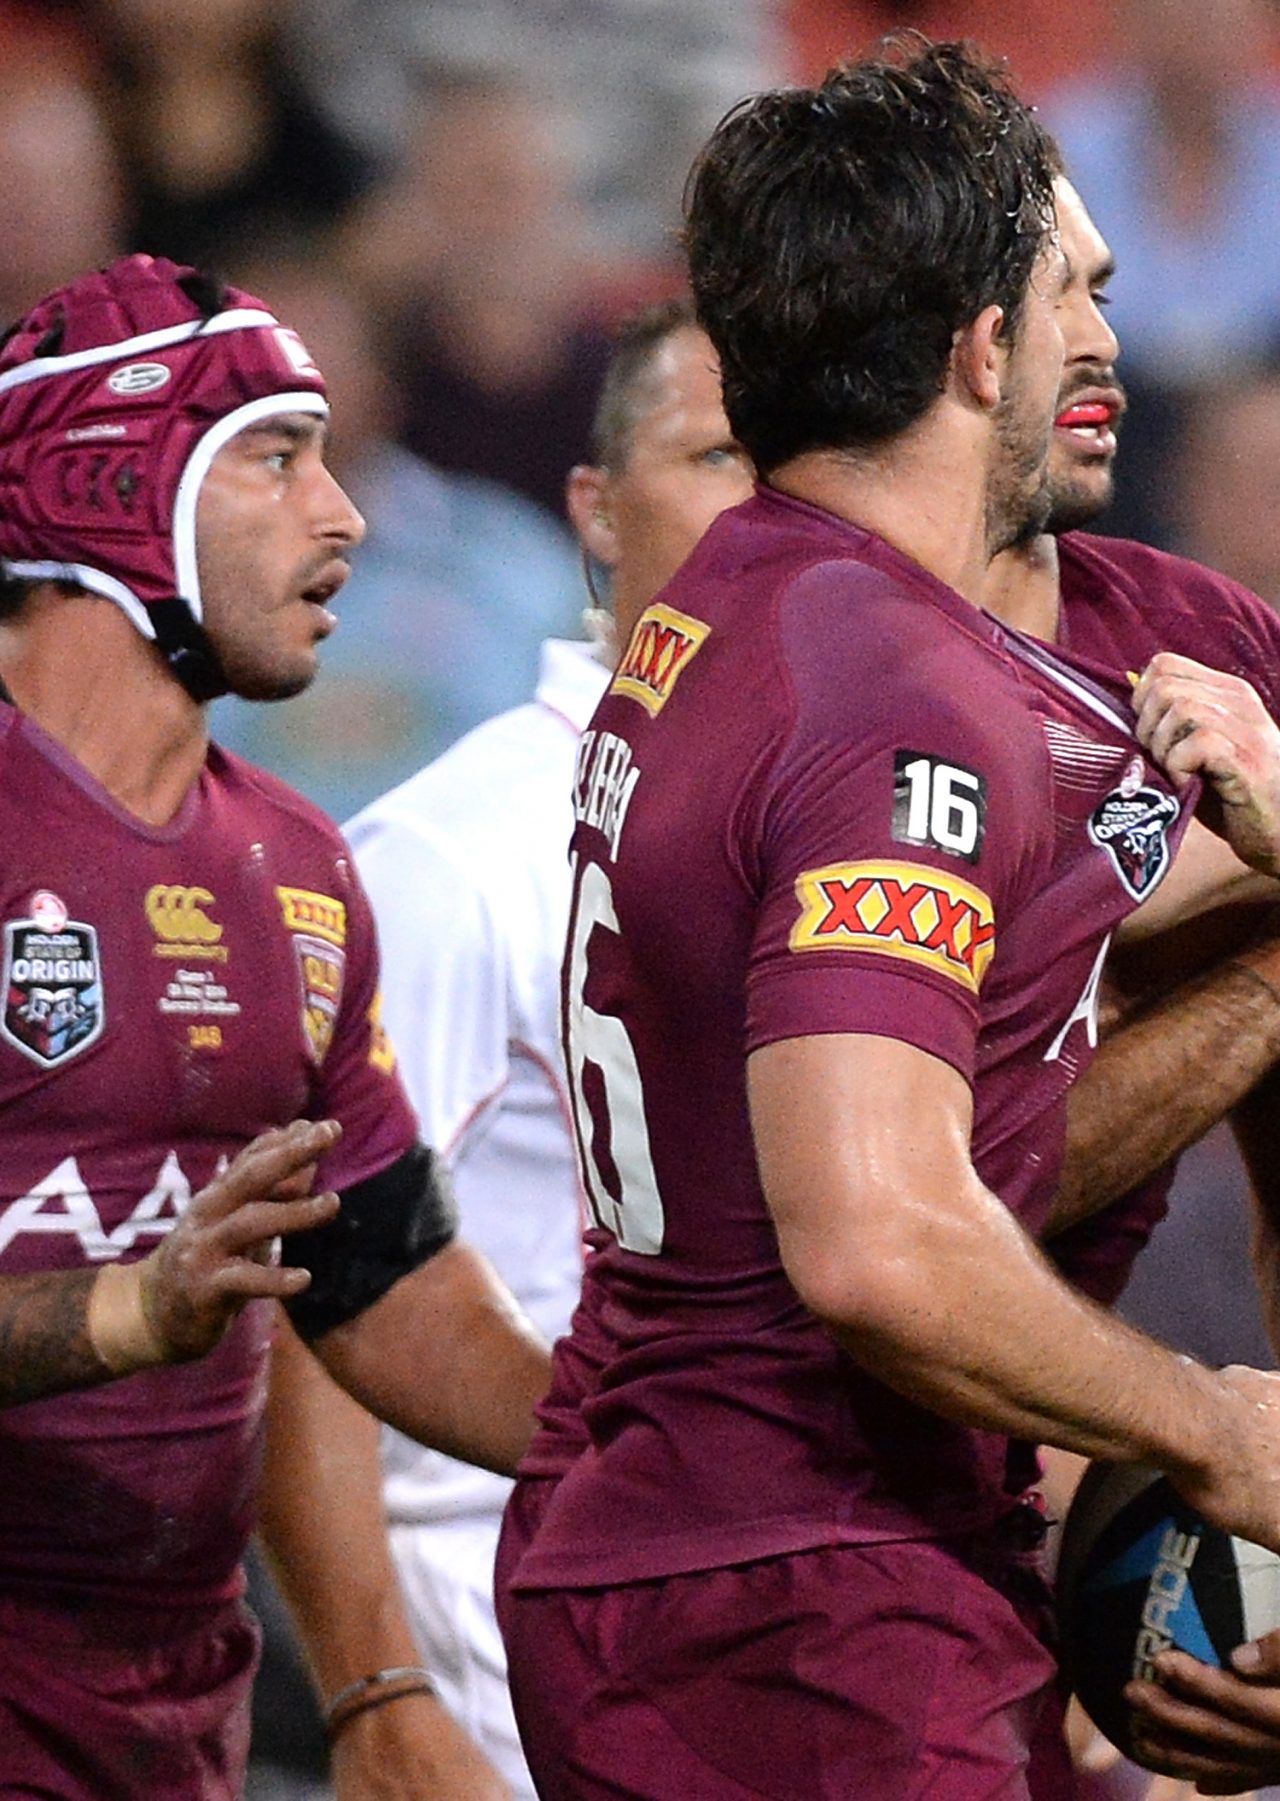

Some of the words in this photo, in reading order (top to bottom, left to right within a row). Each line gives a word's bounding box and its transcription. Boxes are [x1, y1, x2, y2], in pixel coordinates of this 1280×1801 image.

[905, 759, 979, 855] 16
[12, 959, 95, 981] ORIGIN
[812, 878, 996, 973] XXXX
[564, 850, 665, 1256] 6
